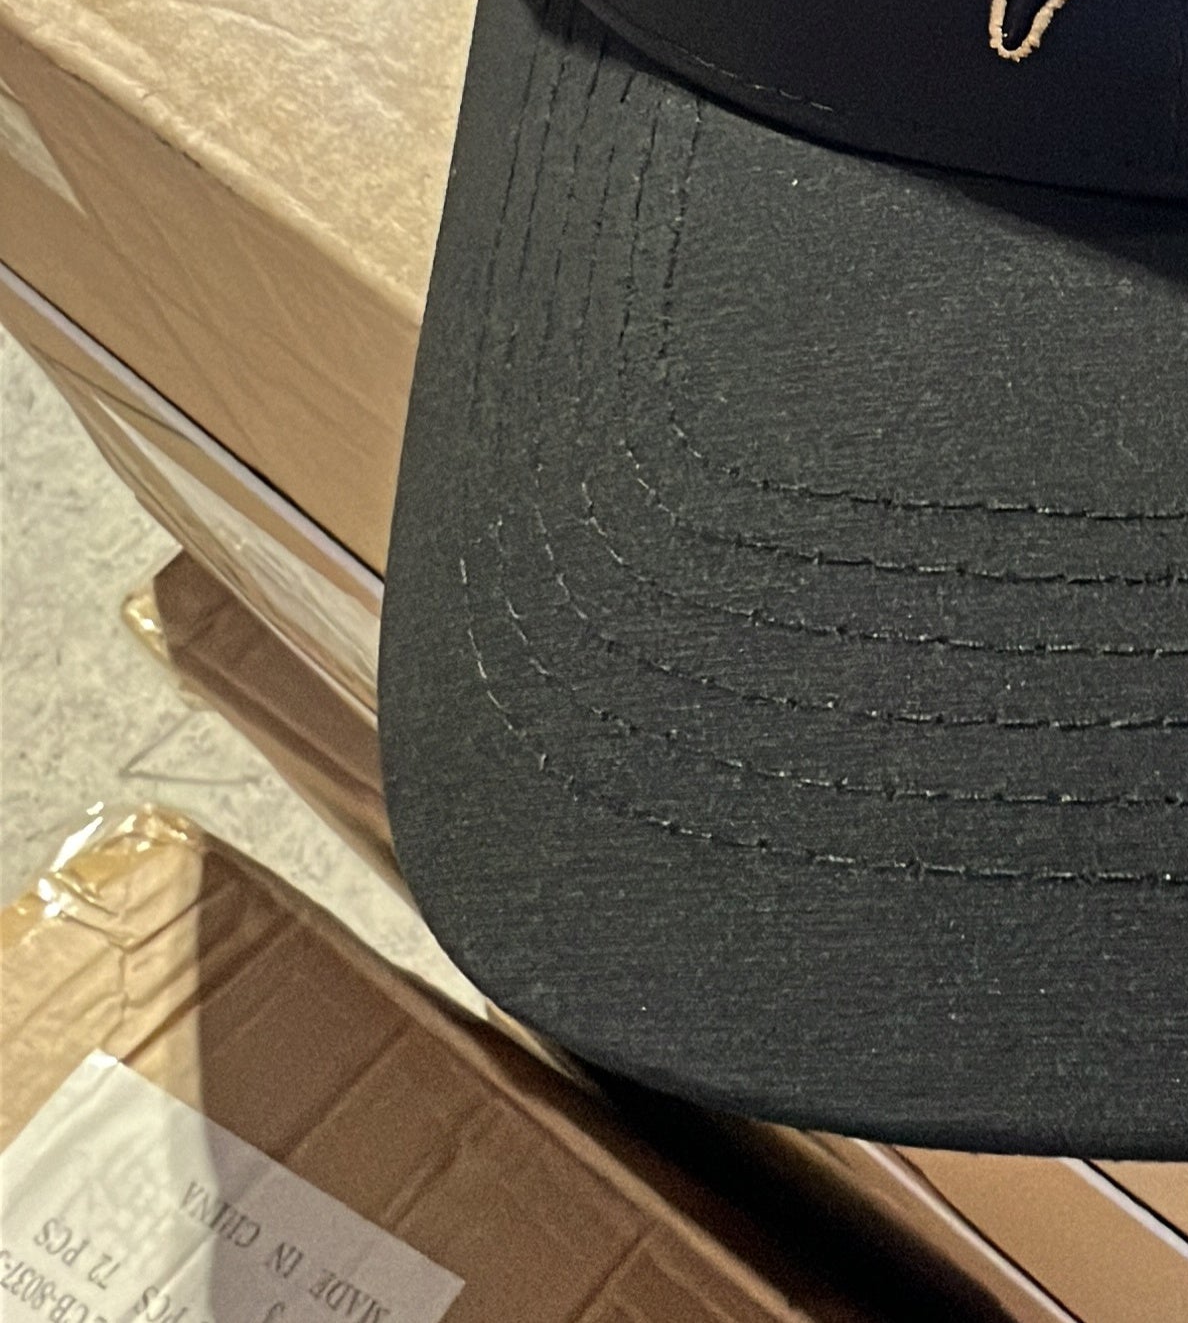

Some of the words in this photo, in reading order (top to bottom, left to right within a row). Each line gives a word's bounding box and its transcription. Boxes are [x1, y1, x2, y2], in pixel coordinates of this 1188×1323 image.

[178, 1181, 261, 1248] CHINA
[33, 1218, 90, 1267] PCS
[273, 1241, 305, 1278] IN
[88, 1253, 121, 1290] 72
